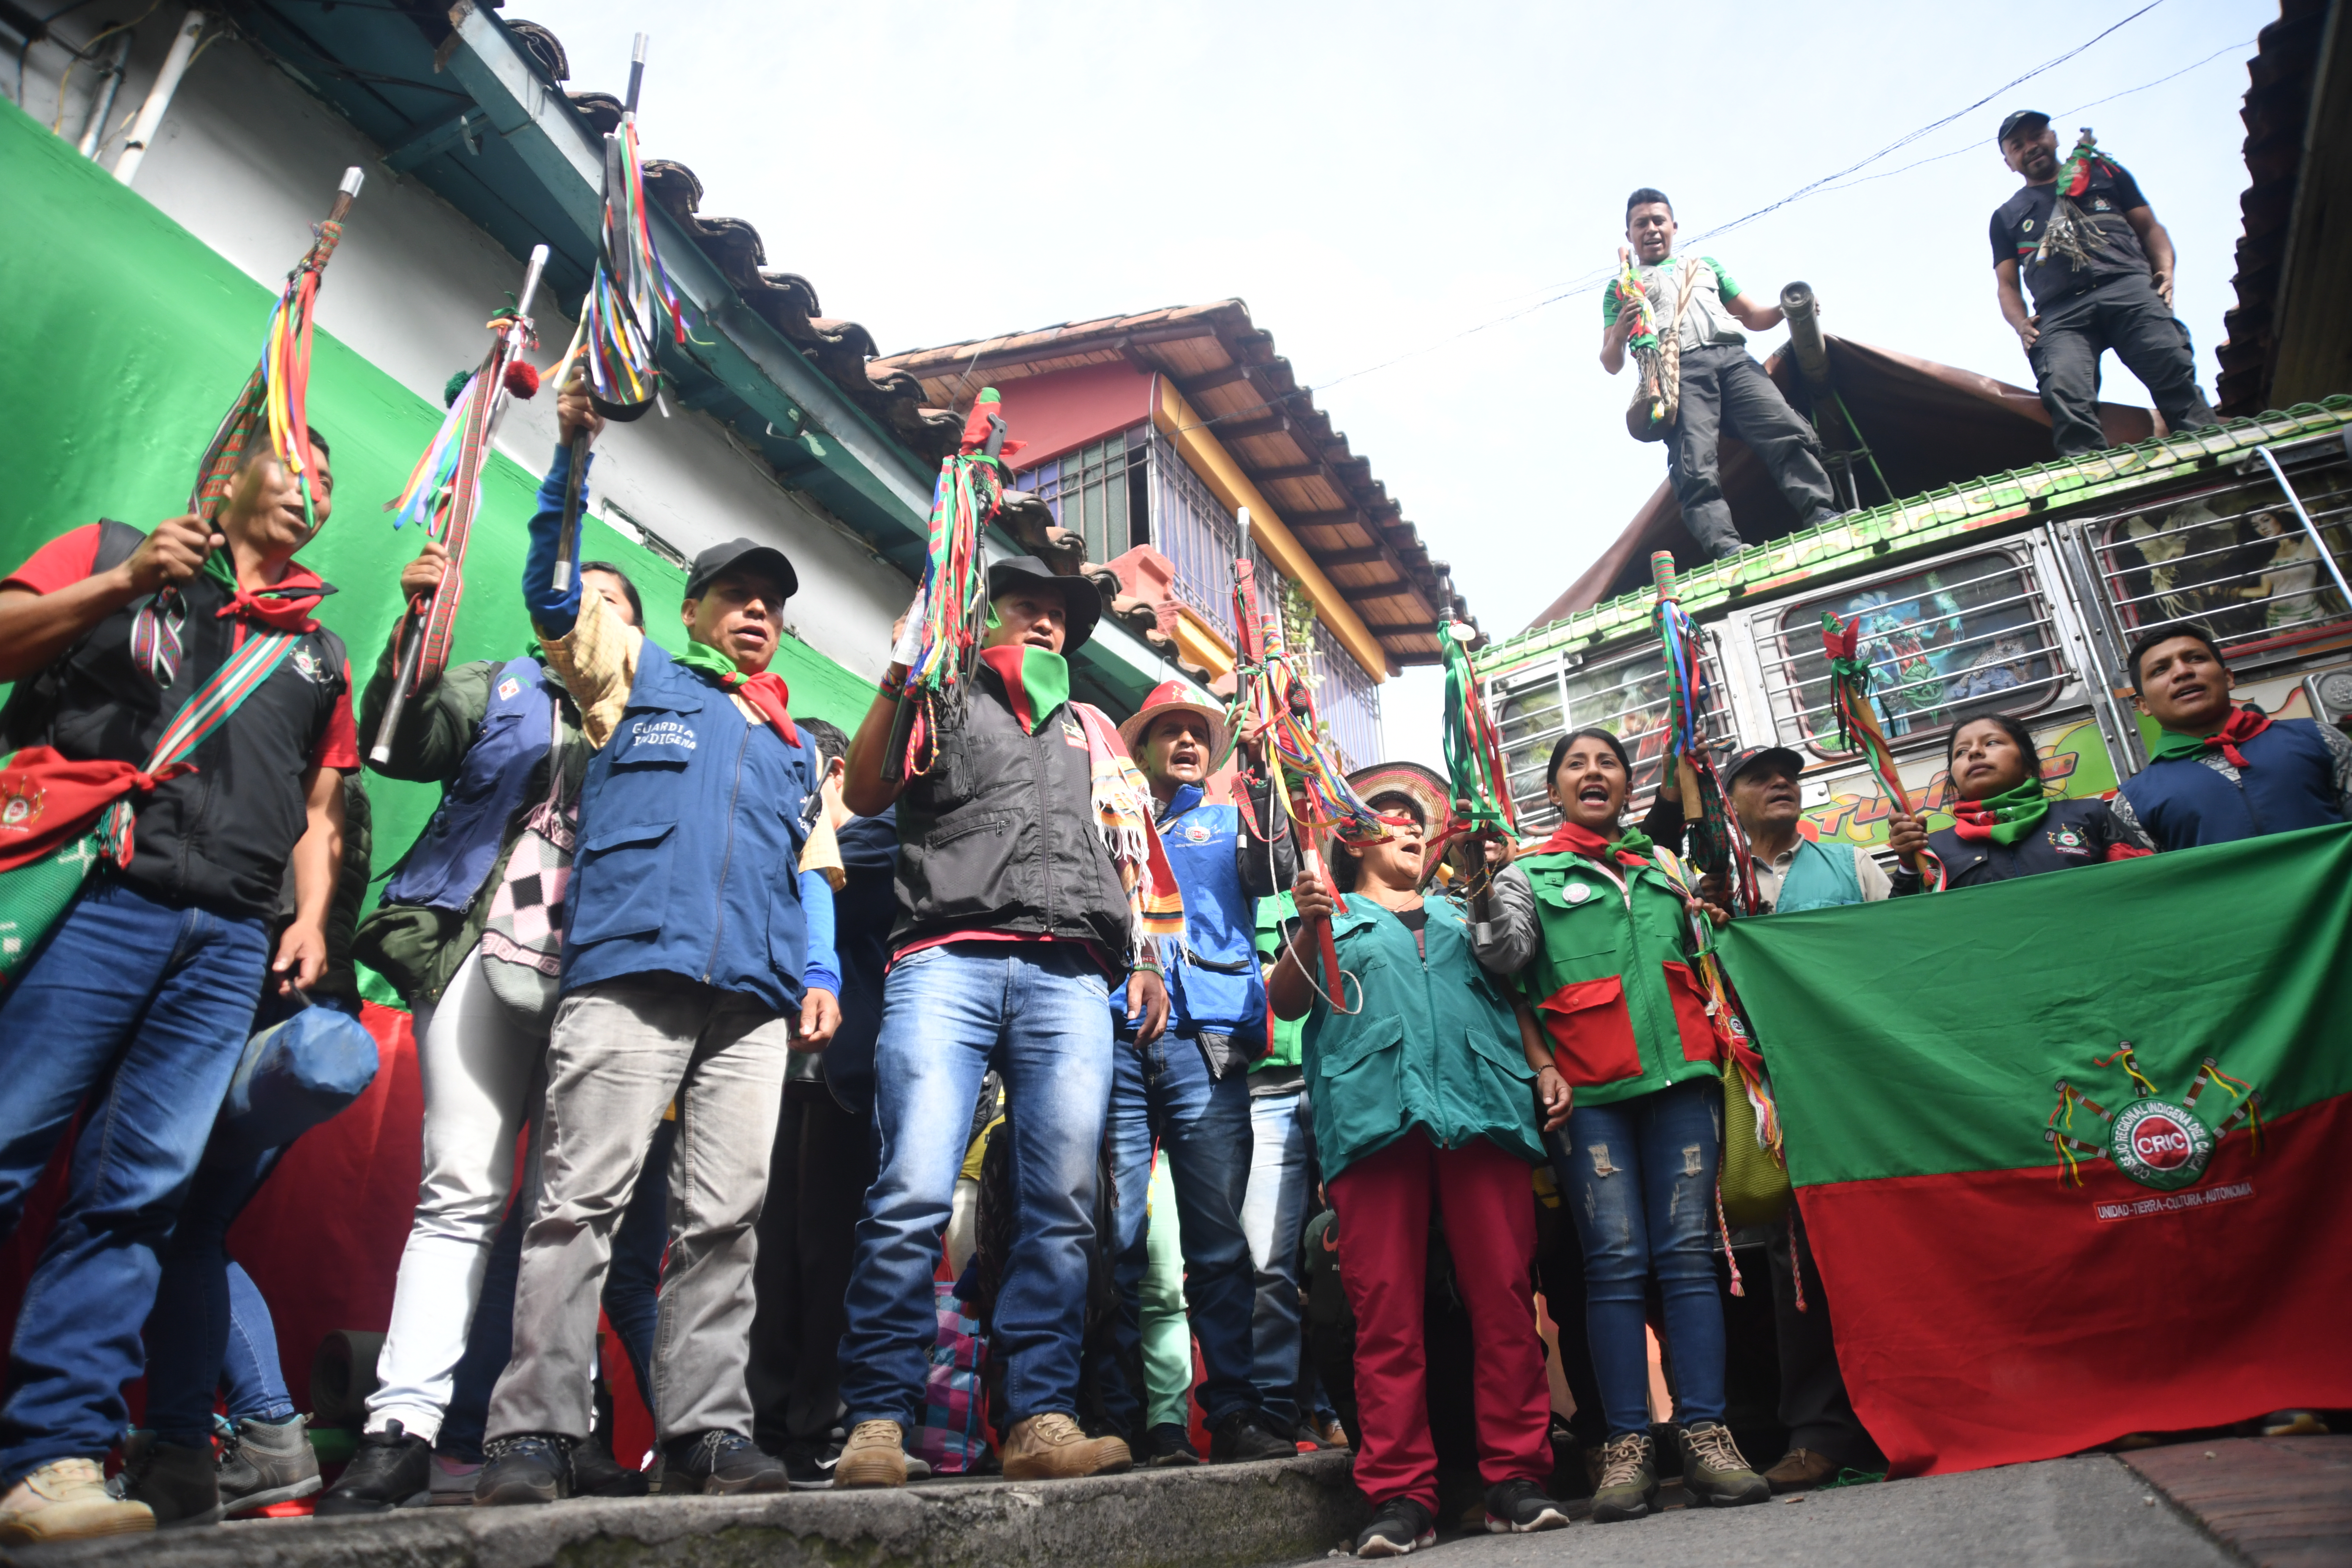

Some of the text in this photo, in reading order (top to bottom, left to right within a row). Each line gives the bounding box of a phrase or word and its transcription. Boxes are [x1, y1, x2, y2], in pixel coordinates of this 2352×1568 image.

[632, 721, 694, 738] GUARDIA
[633, 733, 697, 749] INDIGENA
[2115, 1102, 2209, 1179] CONSEJO REGIONAL INDIGENA DEL CAUCA
[2137, 1132, 2186, 1154] CRIC
